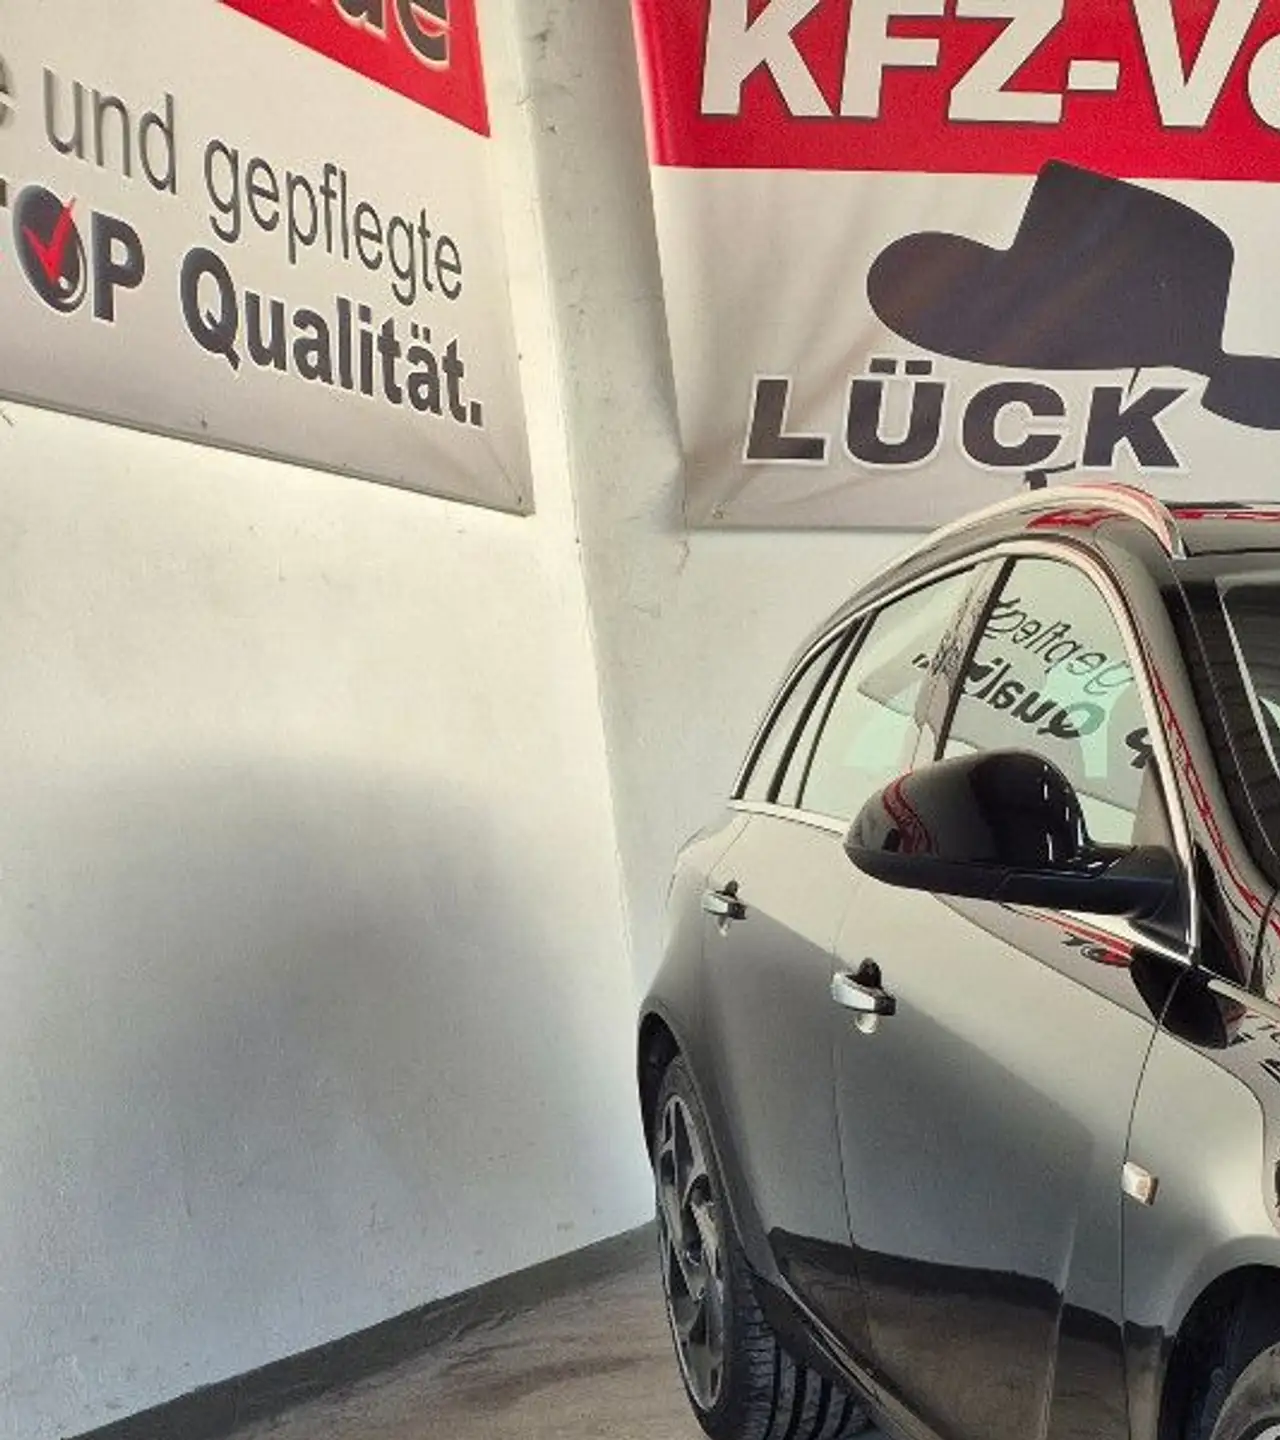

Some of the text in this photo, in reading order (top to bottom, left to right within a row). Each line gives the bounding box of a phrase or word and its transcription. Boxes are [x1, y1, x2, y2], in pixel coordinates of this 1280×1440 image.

[0, 178, 483, 428] OP Qualität.
[43, 66, 177, 196] und
[203, 137, 464, 306] gepflegte
[746, 357, 1188, 469] LÜCK
